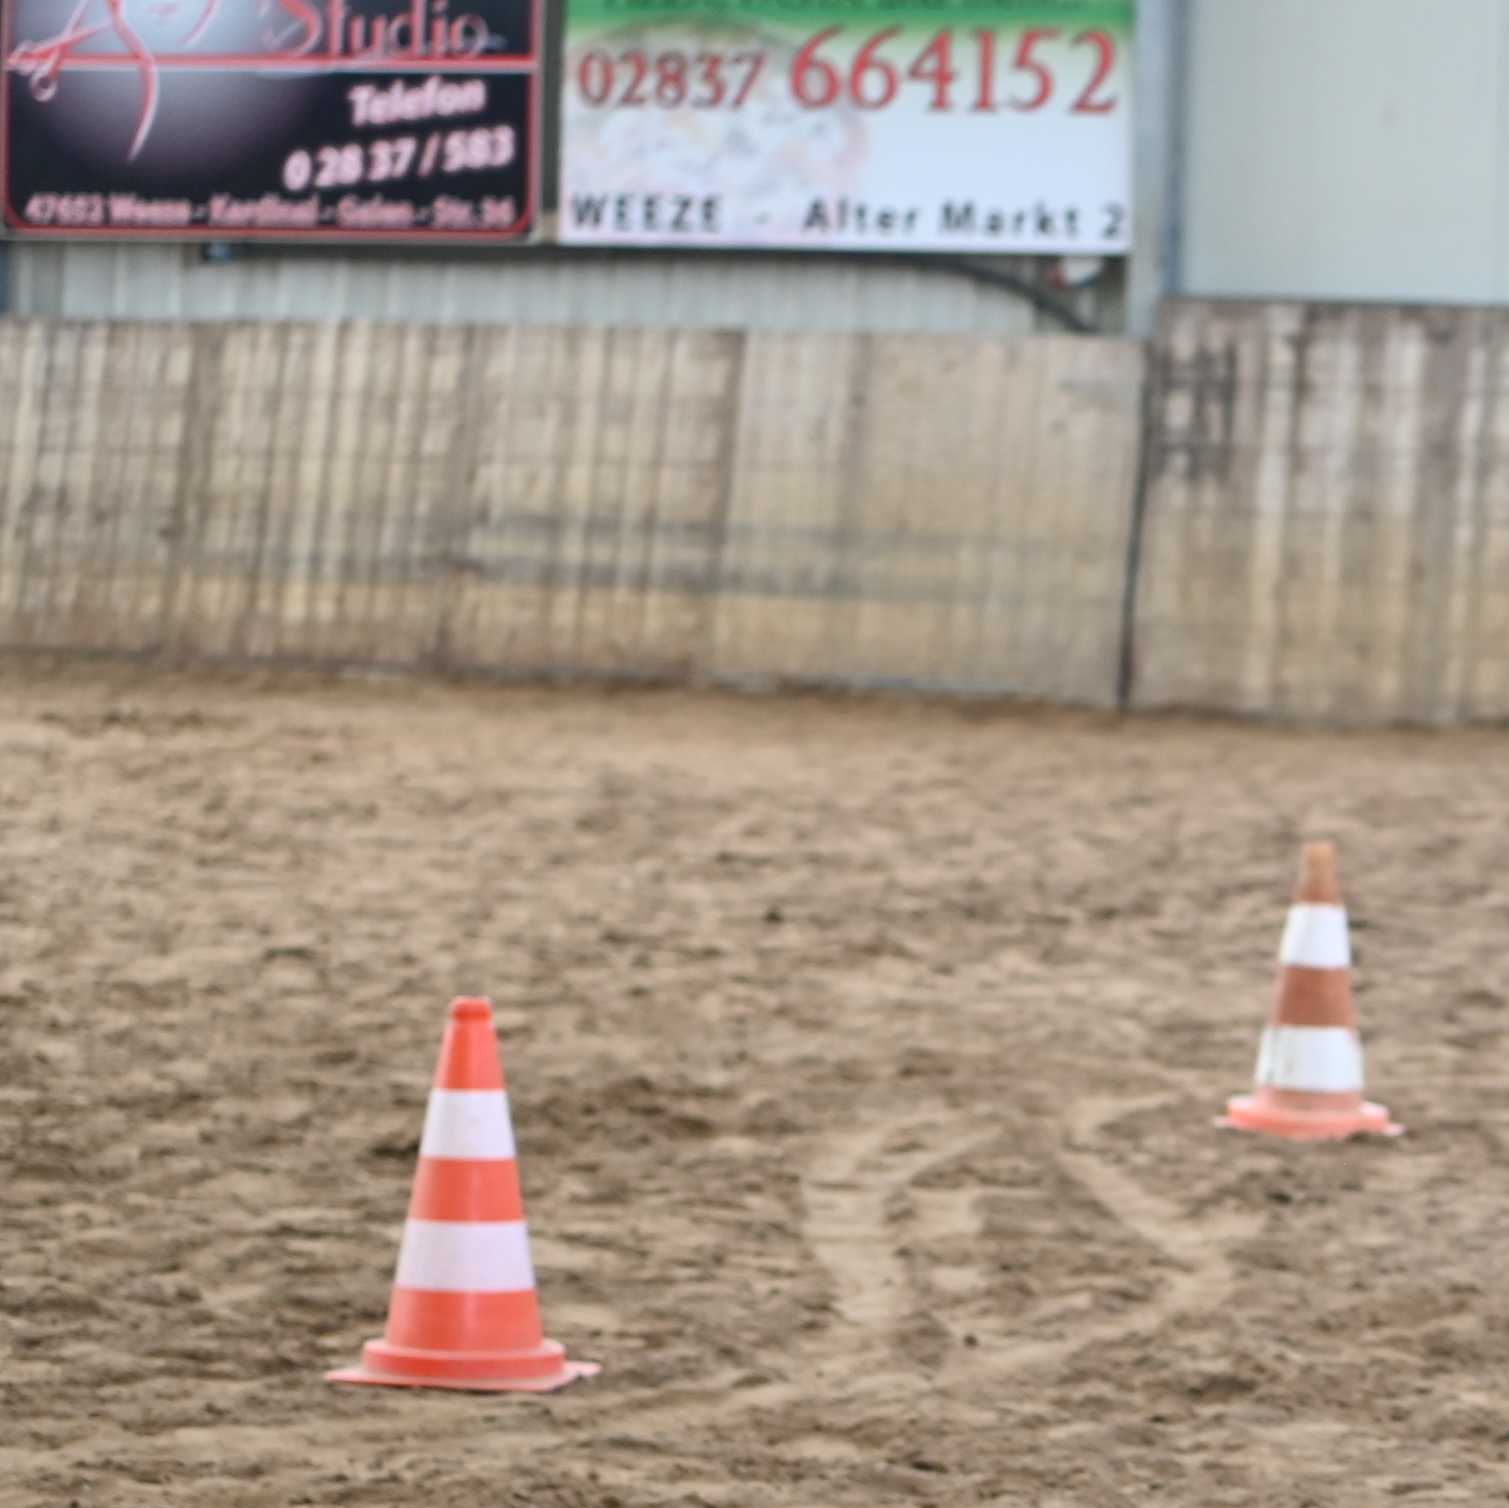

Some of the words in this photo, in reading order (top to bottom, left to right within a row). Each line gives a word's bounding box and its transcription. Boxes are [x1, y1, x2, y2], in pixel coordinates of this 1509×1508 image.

[576, 48, 765, 111] 02837
[791, 23, 1121, 118] 664152
[348, 75, 486, 127] Telefon
[571, 195, 722, 232] WEEZE
[803, 198, 918, 232] Alter
[940, 201, 1081, 236] Markt
[1102, 203, 1125, 240] 2
